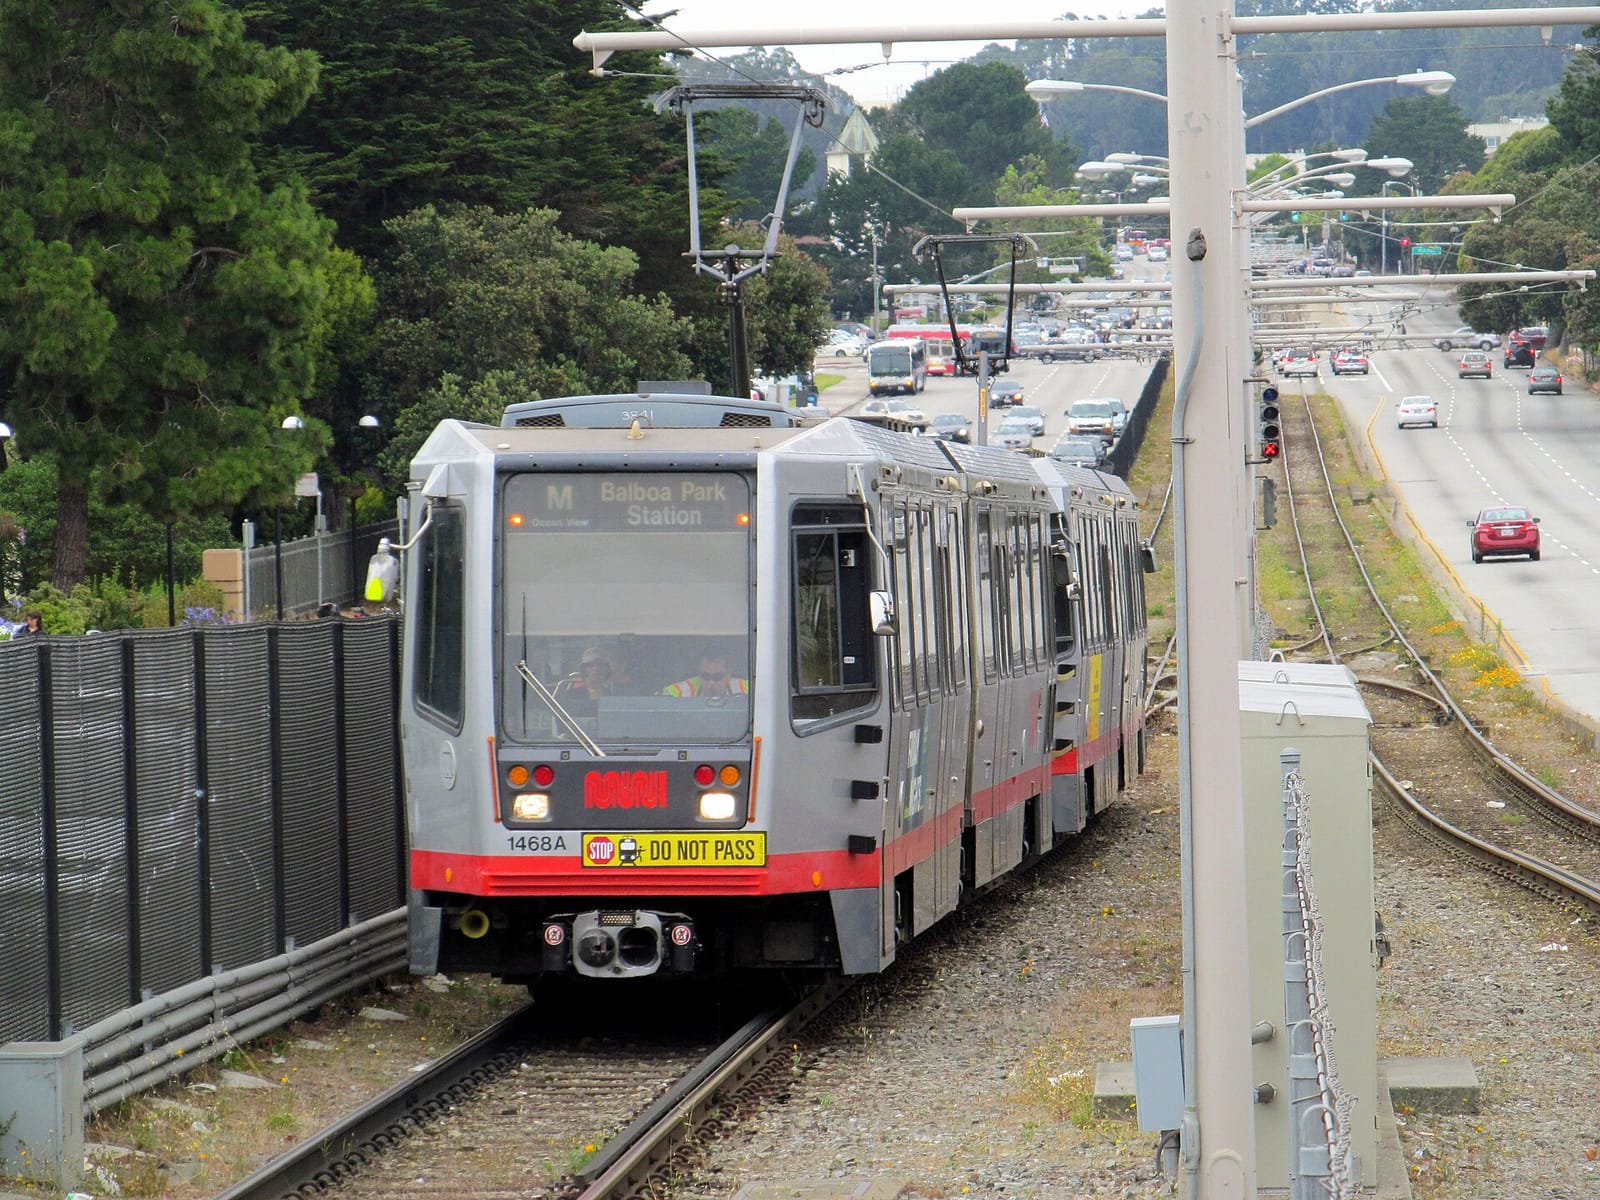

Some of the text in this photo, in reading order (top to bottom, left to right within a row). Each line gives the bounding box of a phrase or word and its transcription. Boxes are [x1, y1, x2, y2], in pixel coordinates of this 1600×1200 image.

[547, 486, 574, 510] M
[600, 482, 728, 501] Balboa Park
[627, 506, 702, 526] Station
[589, 842, 614, 859] STOP
[650, 840, 671, 860] DO
[677, 840, 709, 860] NOT
[714, 840, 755, 860] PASS
